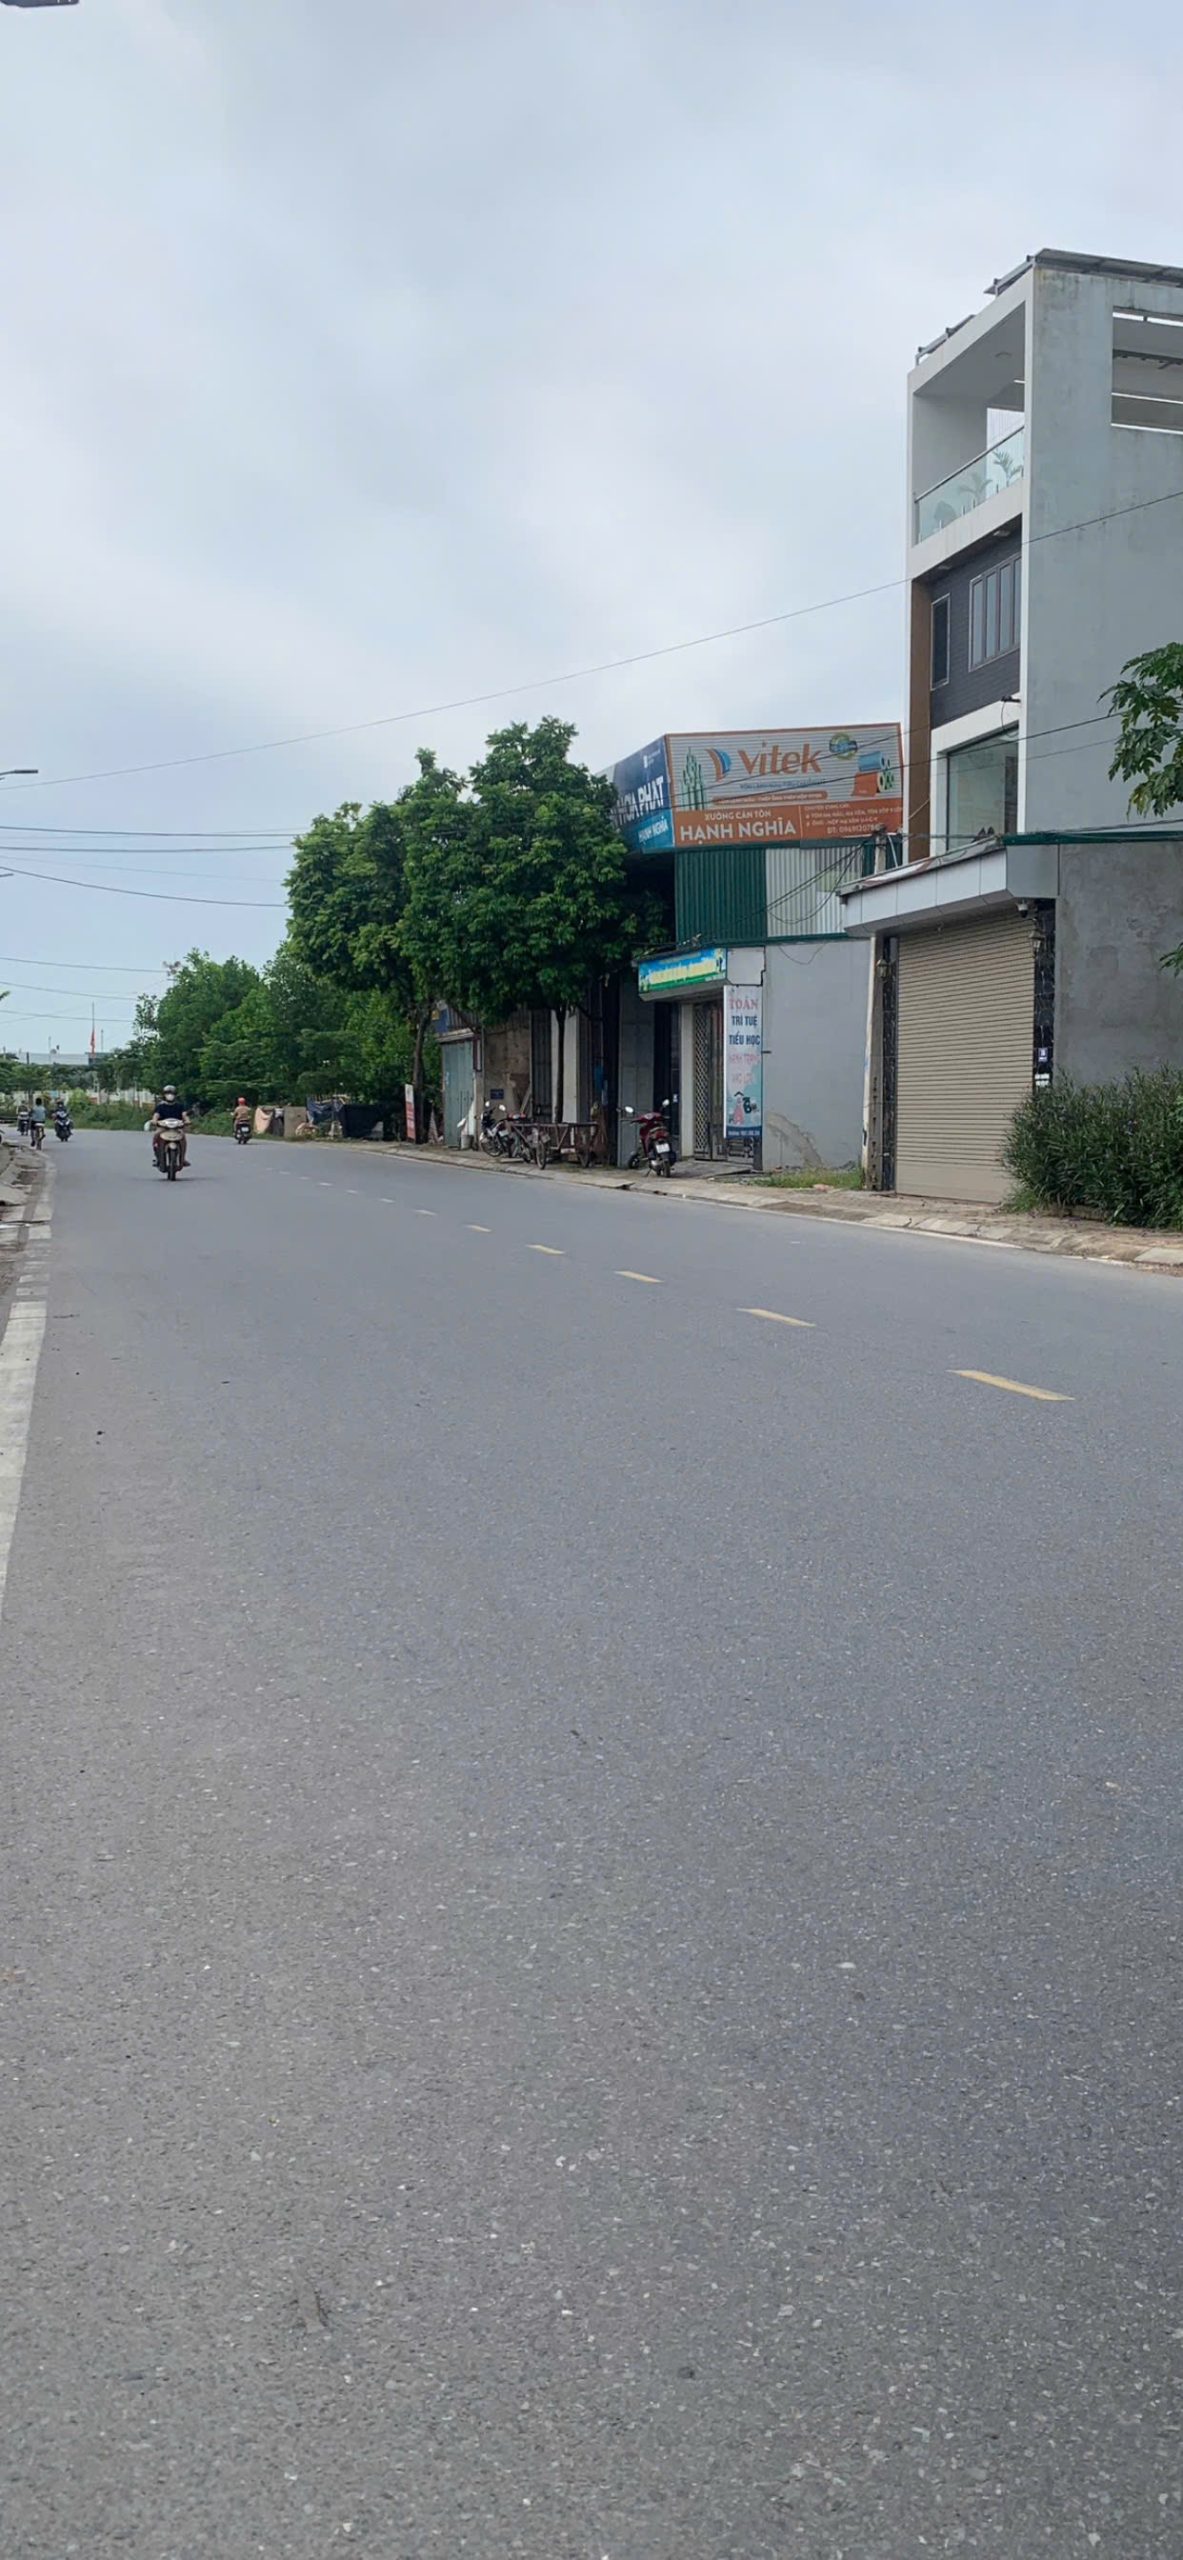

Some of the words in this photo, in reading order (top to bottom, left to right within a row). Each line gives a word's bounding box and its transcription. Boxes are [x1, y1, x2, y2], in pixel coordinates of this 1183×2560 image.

[680, 823, 733, 844] HẠNH
[738, 817, 797, 838] NGHĨA
[744, 1014, 758, 1028] TUỆ
[746, 1034, 761, 1047] HỌC
